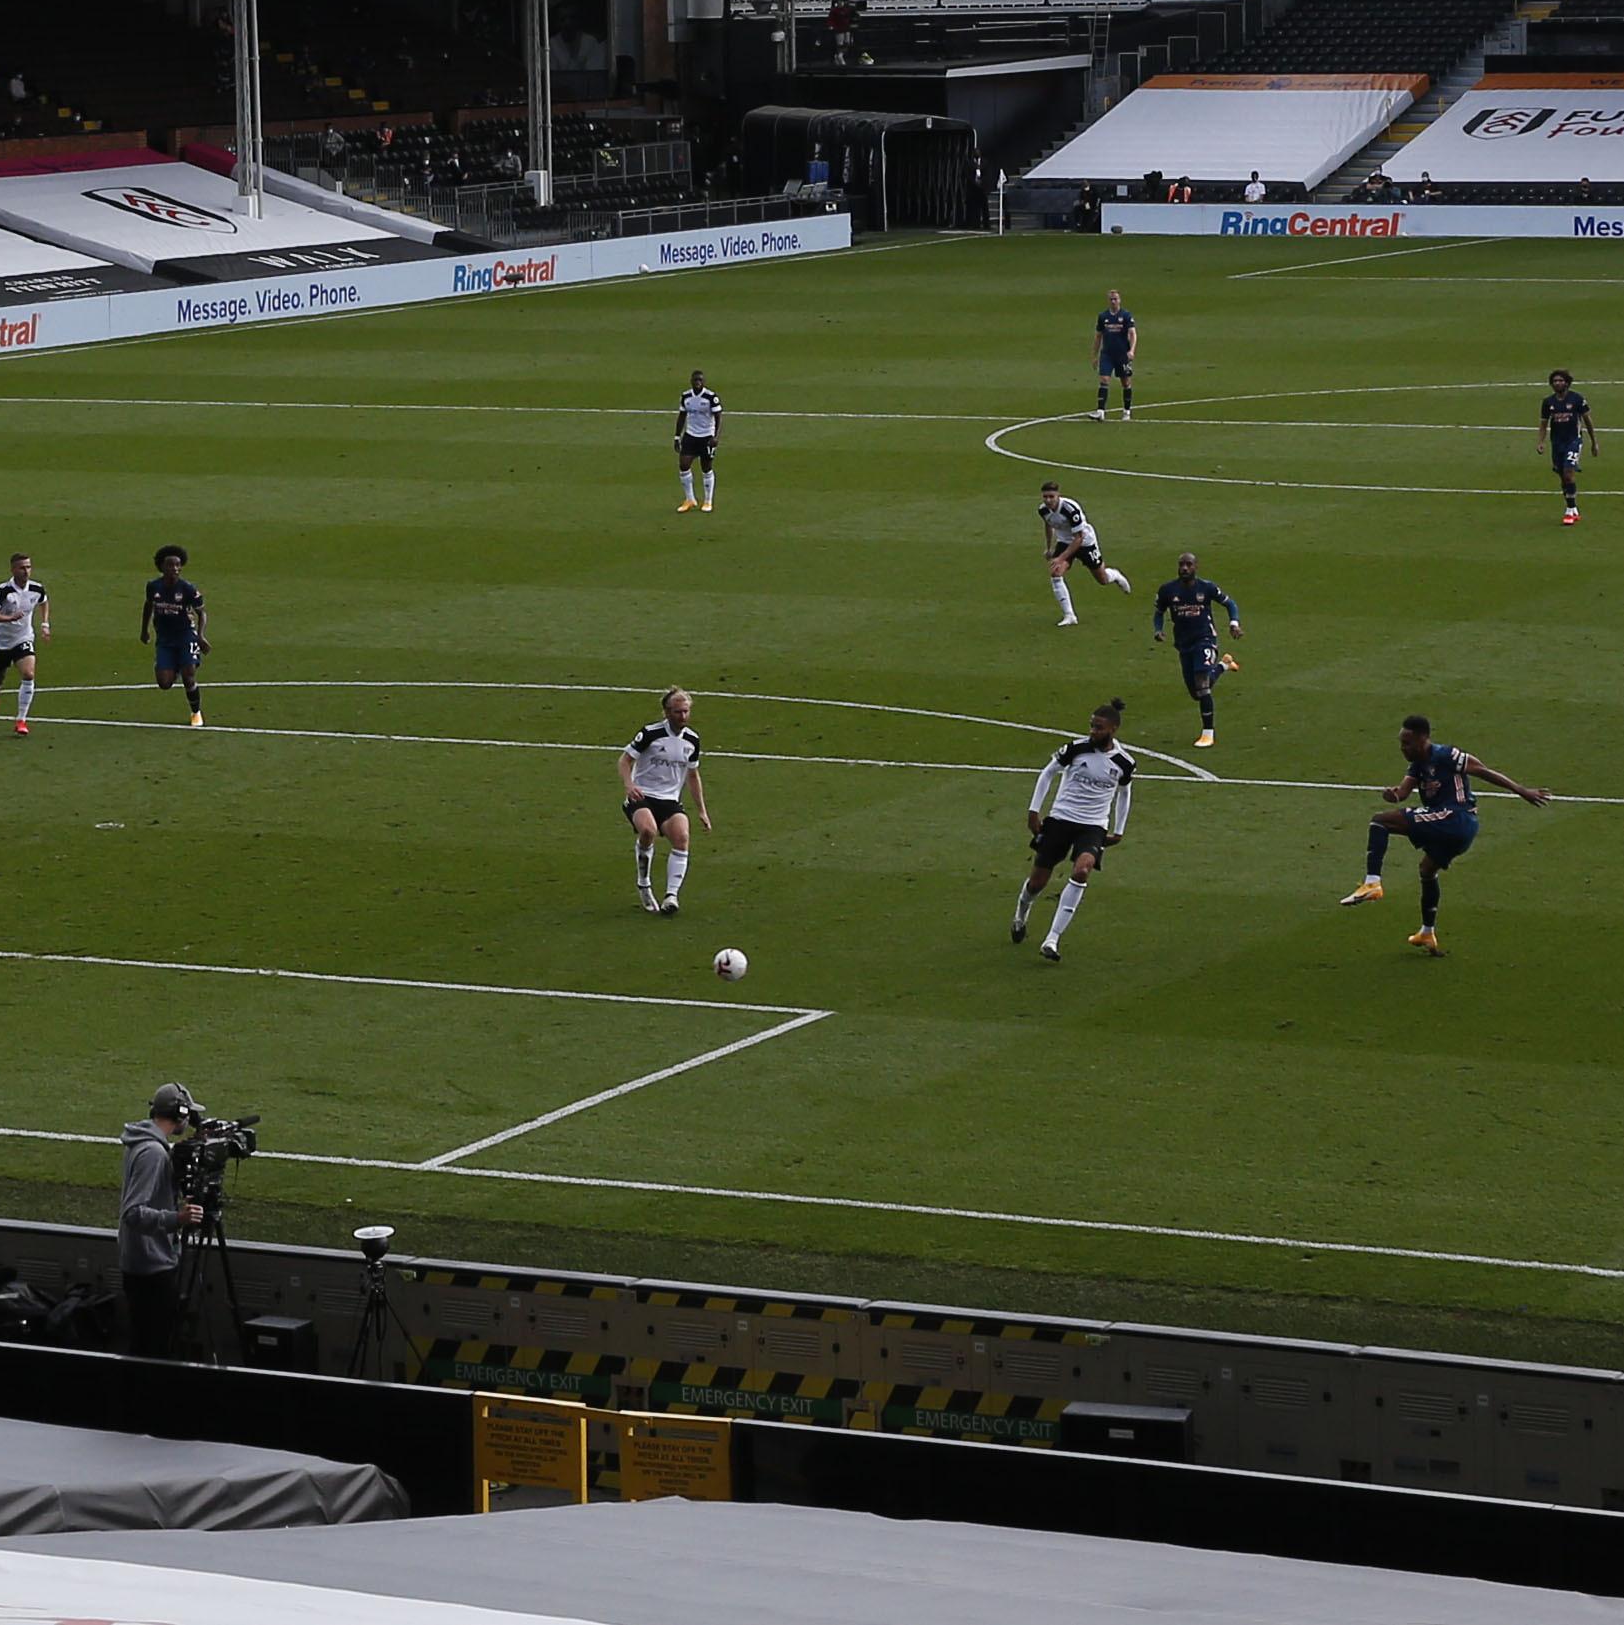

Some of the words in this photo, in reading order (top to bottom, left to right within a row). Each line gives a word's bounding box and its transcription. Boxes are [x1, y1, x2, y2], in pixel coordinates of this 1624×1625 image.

[1220, 211, 1401, 236] RingCentral
[659, 236, 719, 265] Message.
[719, 234, 759, 258] Video.
[760, 231, 802, 252] Phone.
[176, 295, 252, 325] Message.
[254, 288, 305, 313] Video.
[308, 284, 362, 307] Phone.
[454, 1364, 549, 1390] EMERGENCY
[549, 1376, 583, 1394] EXIT
[682, 1385, 779, 1413] EMERGENCY
[780, 1398, 814, 1416] EXIT
[916, 1409, 1015, 1436] EMERGENCY
[1018, 1420, 1055, 1439] EXIT
